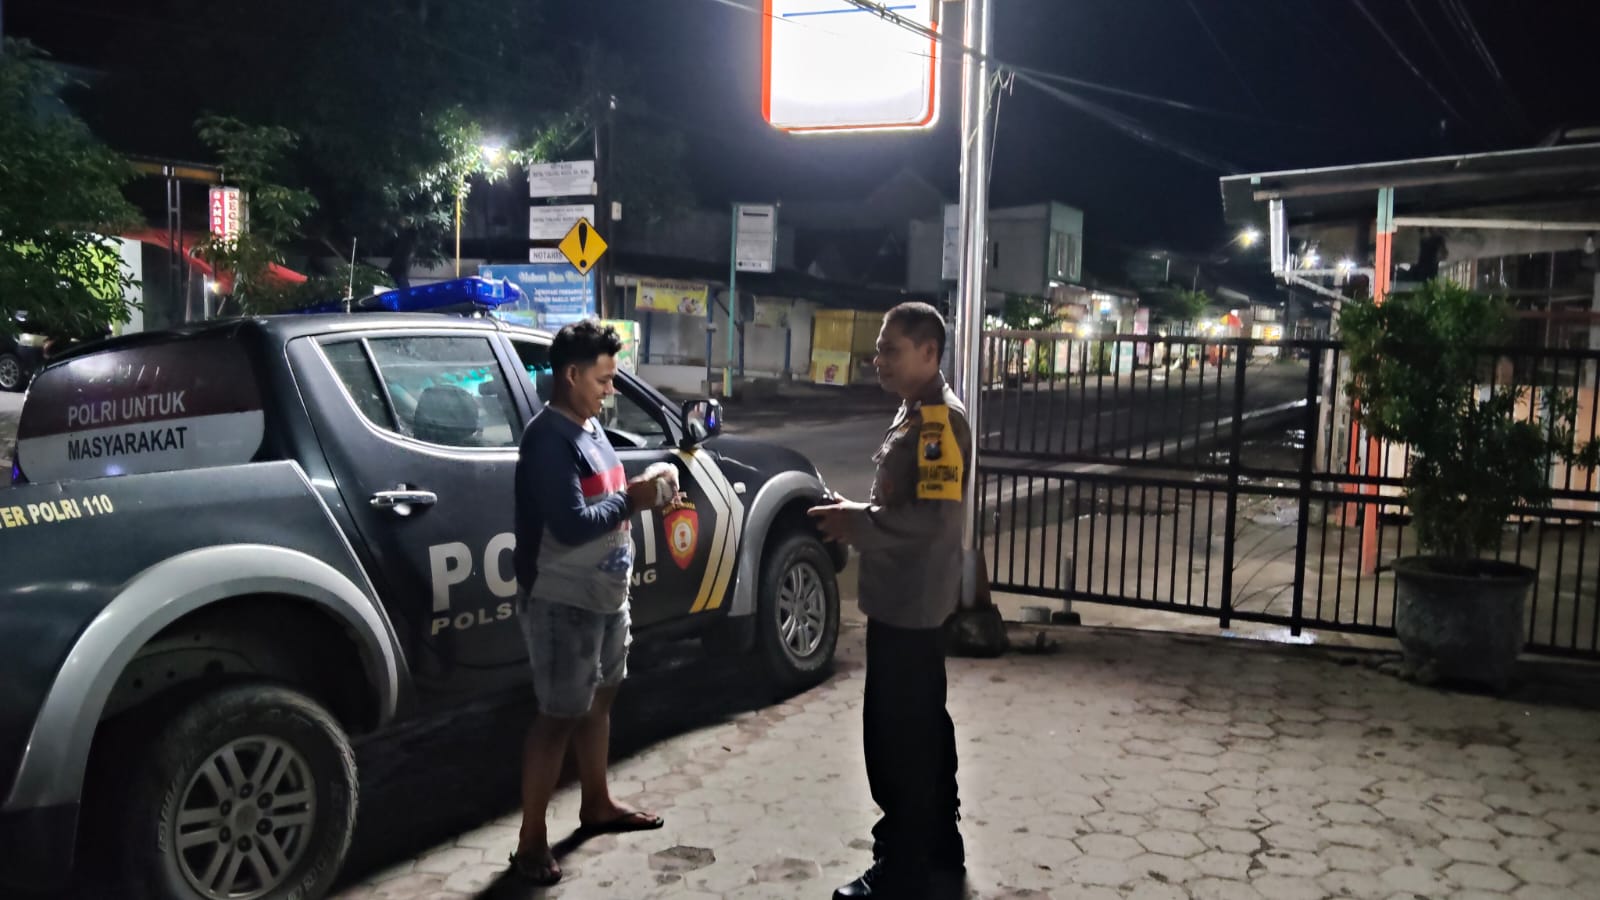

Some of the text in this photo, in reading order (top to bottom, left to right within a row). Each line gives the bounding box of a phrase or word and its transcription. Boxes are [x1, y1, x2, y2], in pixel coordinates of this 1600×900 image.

[533, 250, 564, 260] NOTARIS
[67, 390, 186, 427] POLRI UNTUK
[67, 427, 188, 461] MASYARAKAT
[27, 499, 82, 524] POLRI
[83, 494, 114, 517] 110
